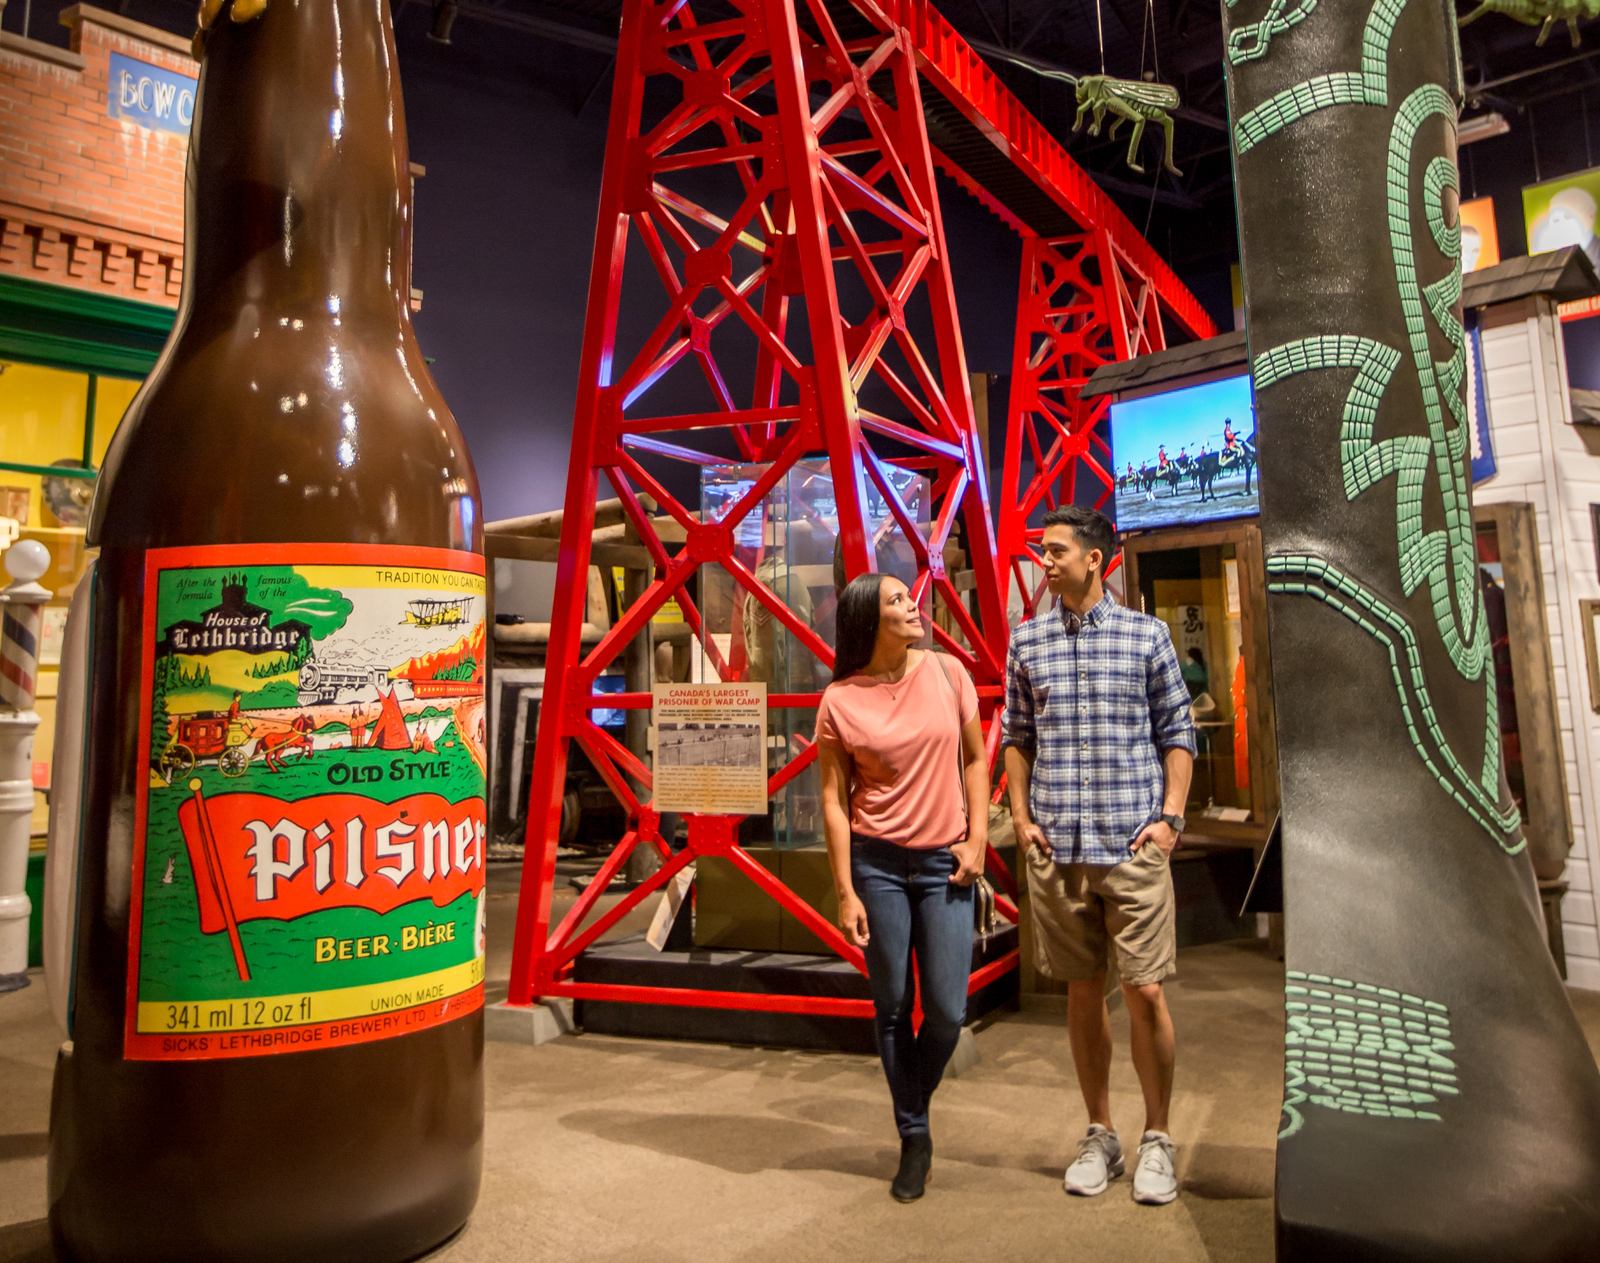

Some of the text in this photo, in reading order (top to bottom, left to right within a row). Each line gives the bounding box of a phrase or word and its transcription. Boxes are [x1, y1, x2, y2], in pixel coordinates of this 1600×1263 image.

[176, 574, 293, 589] After the famous
[376, 571, 439, 585] TRADITION
[442, 575, 460, 587] YOU
[460, 576, 474, 588] CAN
[176, 586, 287, 604] formula of the
[250, 612, 267, 625] of
[174, 626, 300, 650] Lethbridge
[658, 697, 761, 706] PRISONER OF WAR CAMP
[669, 689, 749, 698] CANADA'S LARGEST
[387, 760, 451, 781] STYLE
[242, 815, 486, 902] Pilsner
[371, 984, 445, 1011] UNION MADE
[166, 996, 312, 1030] 341 ml 12 oz fl
[220, 1028, 324, 1051] LETHBRIDGE
[330, 1015, 400, 1039] BREWERY
[405, 1009, 426, 1027] LTD
